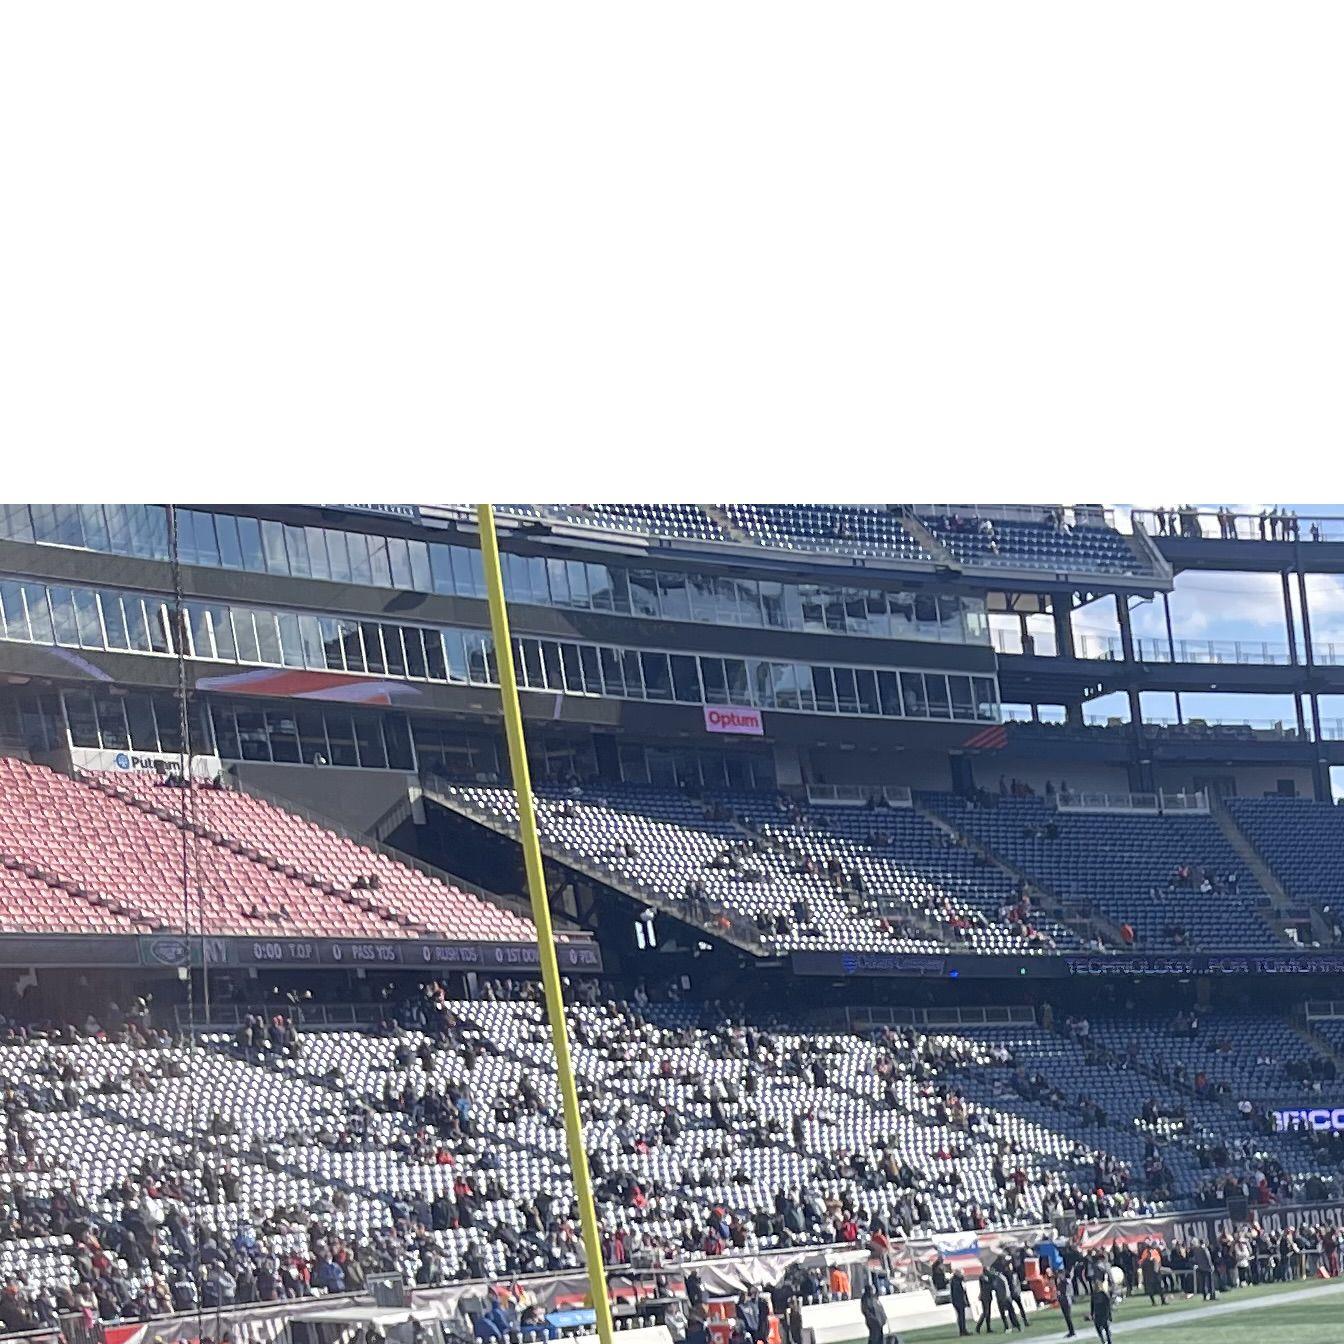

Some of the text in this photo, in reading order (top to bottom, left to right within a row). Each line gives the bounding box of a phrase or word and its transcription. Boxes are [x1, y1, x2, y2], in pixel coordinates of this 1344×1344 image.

[709, 711, 760, 729] Optum
[252, 945, 283, 961] 0:00
[352, 945, 373, 961] PASS
[376, 946, 396, 962] YDS
